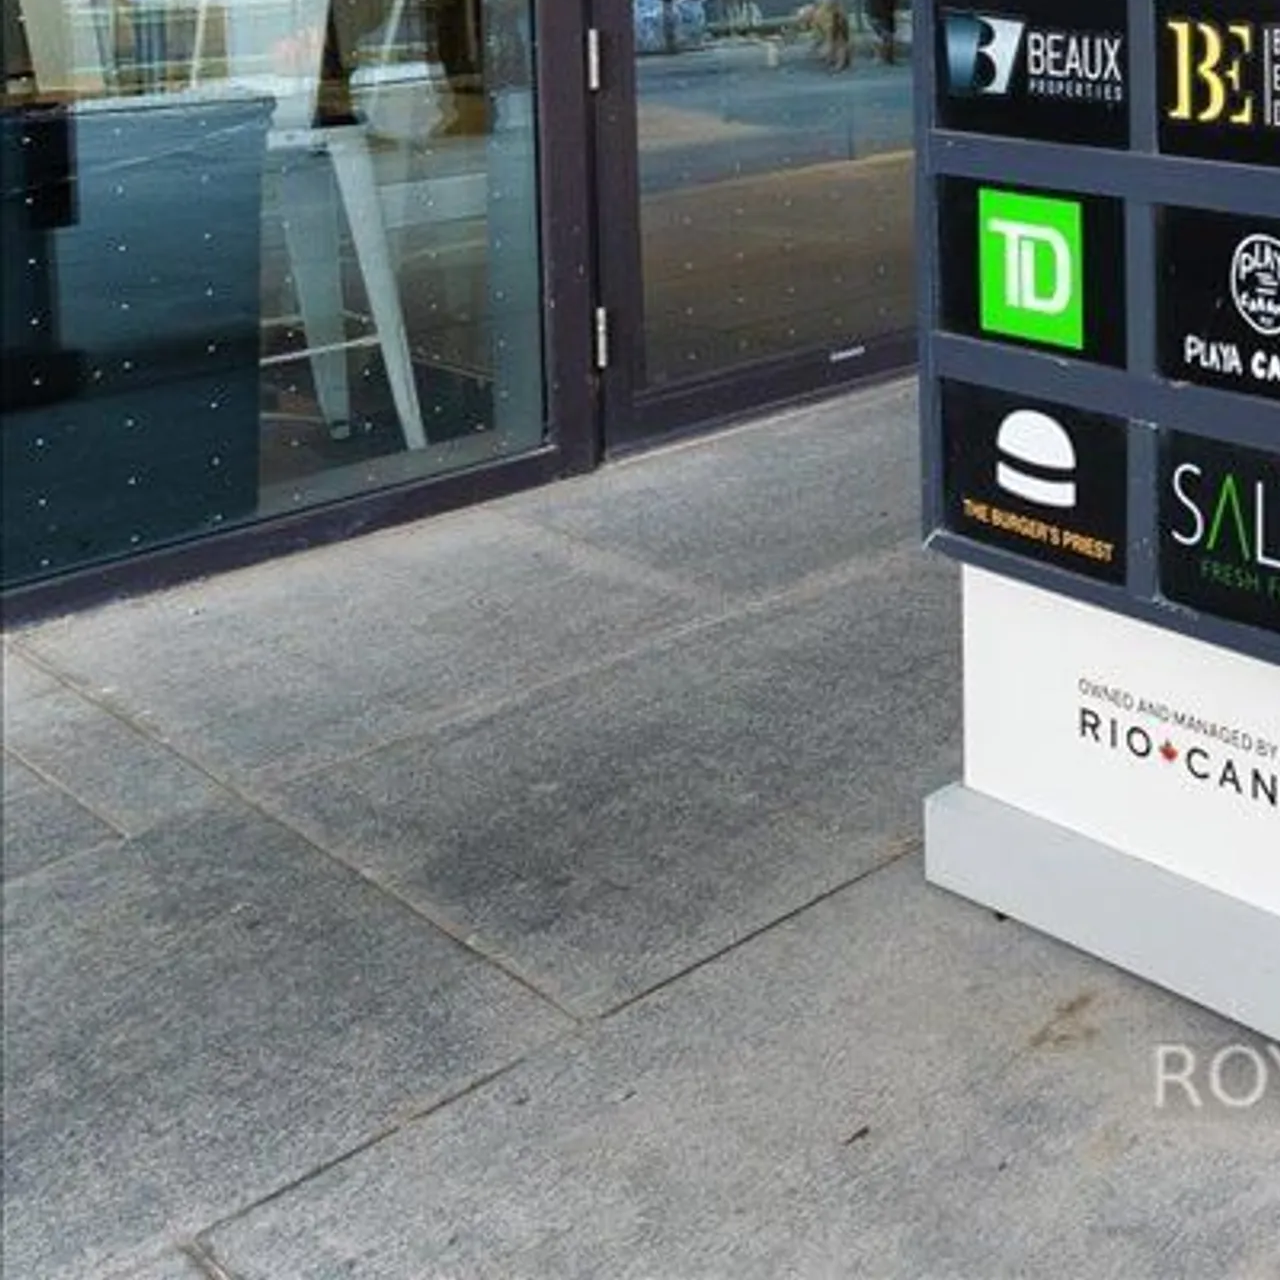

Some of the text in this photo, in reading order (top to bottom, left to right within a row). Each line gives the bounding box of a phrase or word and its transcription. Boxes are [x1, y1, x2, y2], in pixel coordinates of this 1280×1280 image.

[1027, 31, 1122, 81] BEAUX
[1029, 77, 1123, 102] PROPERTIES
[987, 217, 1073, 315] TD
[1184, 334, 1243, 377] PLAYA
[1062, 529, 1115, 562] PRIEST
[1202, 558, 1259, 592] FRESH
[1078, 677, 1279, 760] OWNED AND MANAGED BY
[1079, 707, 1279, 807] RIO CAN
